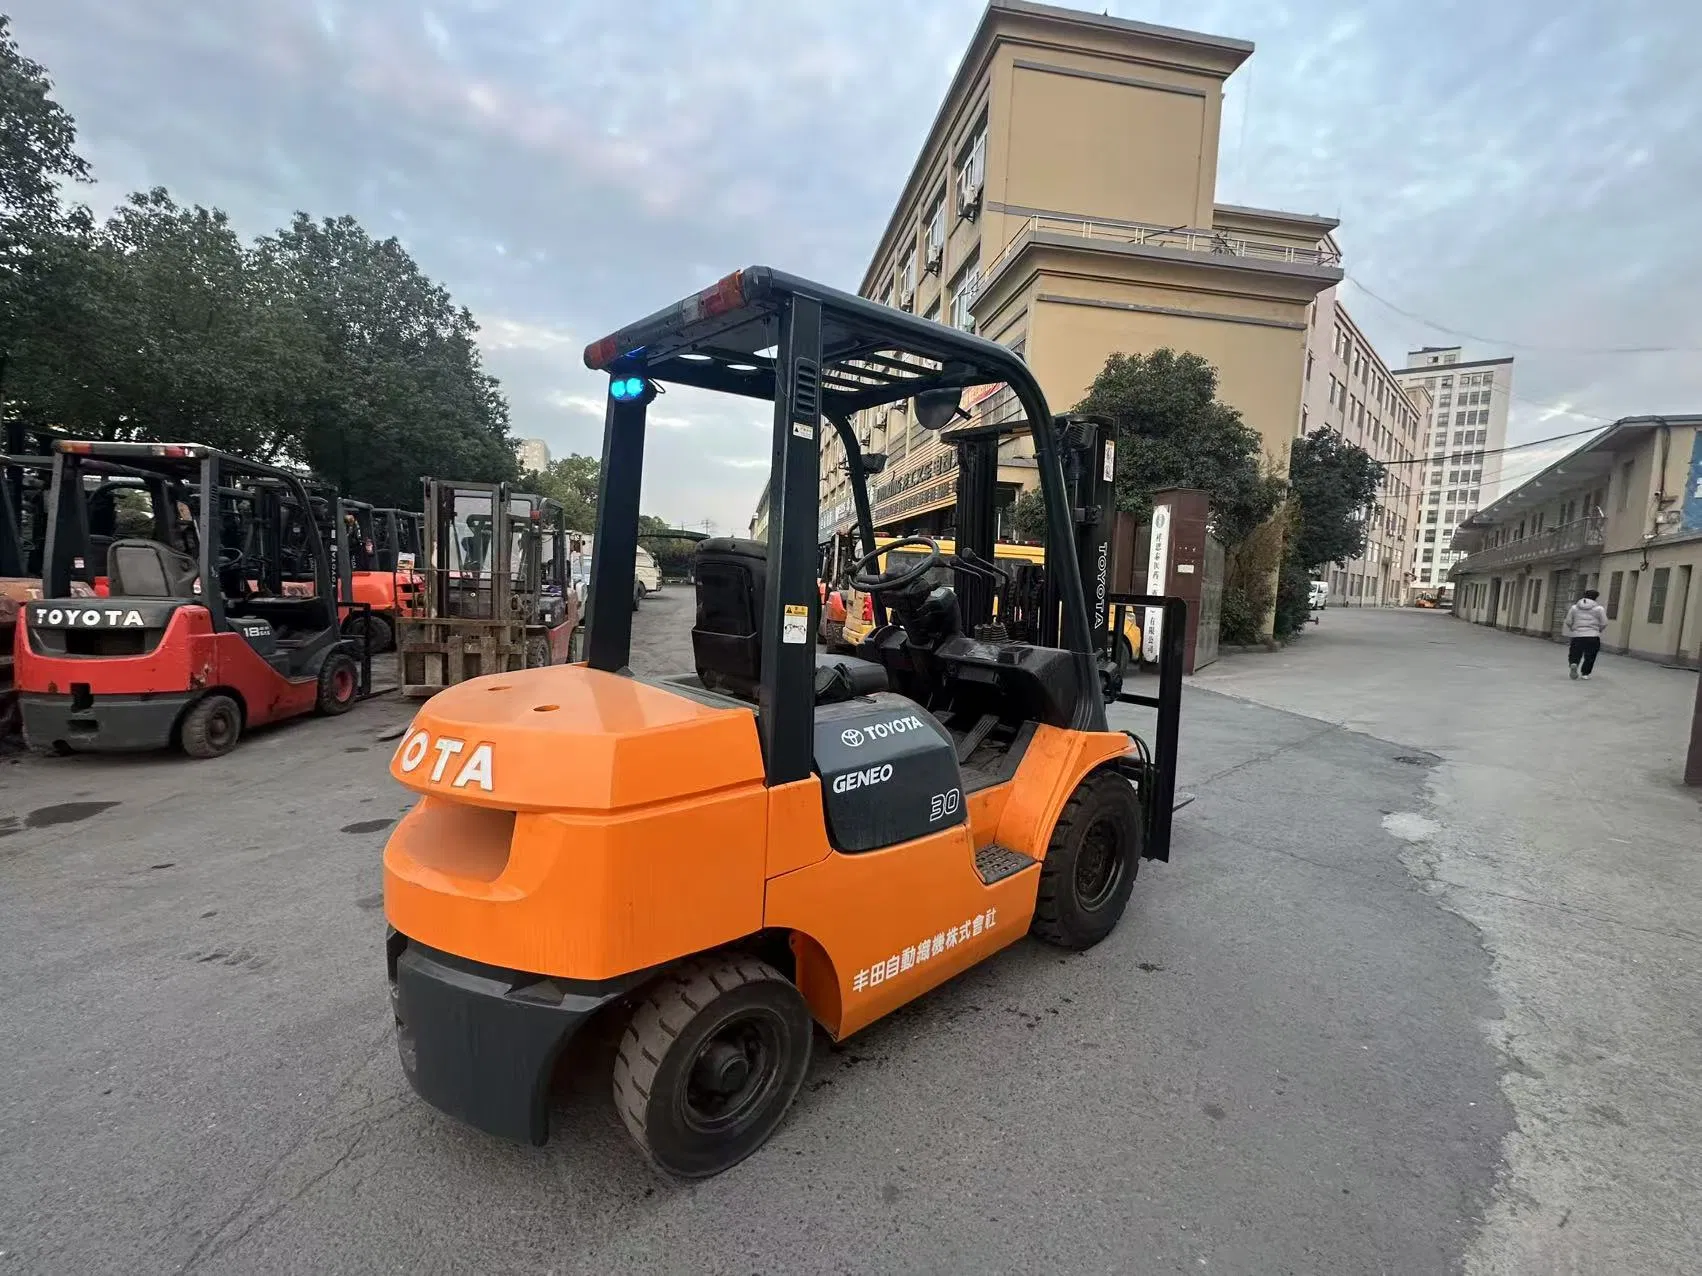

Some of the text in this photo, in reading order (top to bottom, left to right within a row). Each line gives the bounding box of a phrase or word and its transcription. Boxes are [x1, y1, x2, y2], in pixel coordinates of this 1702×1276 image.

[1094, 541, 1108, 629] TOYOTA
[36, 608, 144, 626] TOYOTA
[243, 627, 260, 638] 18
[864, 715, 924, 740] TOYOTA
[402, 729, 493, 791] OTA
[833, 763, 893, 794] GENEO
[929, 787, 960, 822] 30
